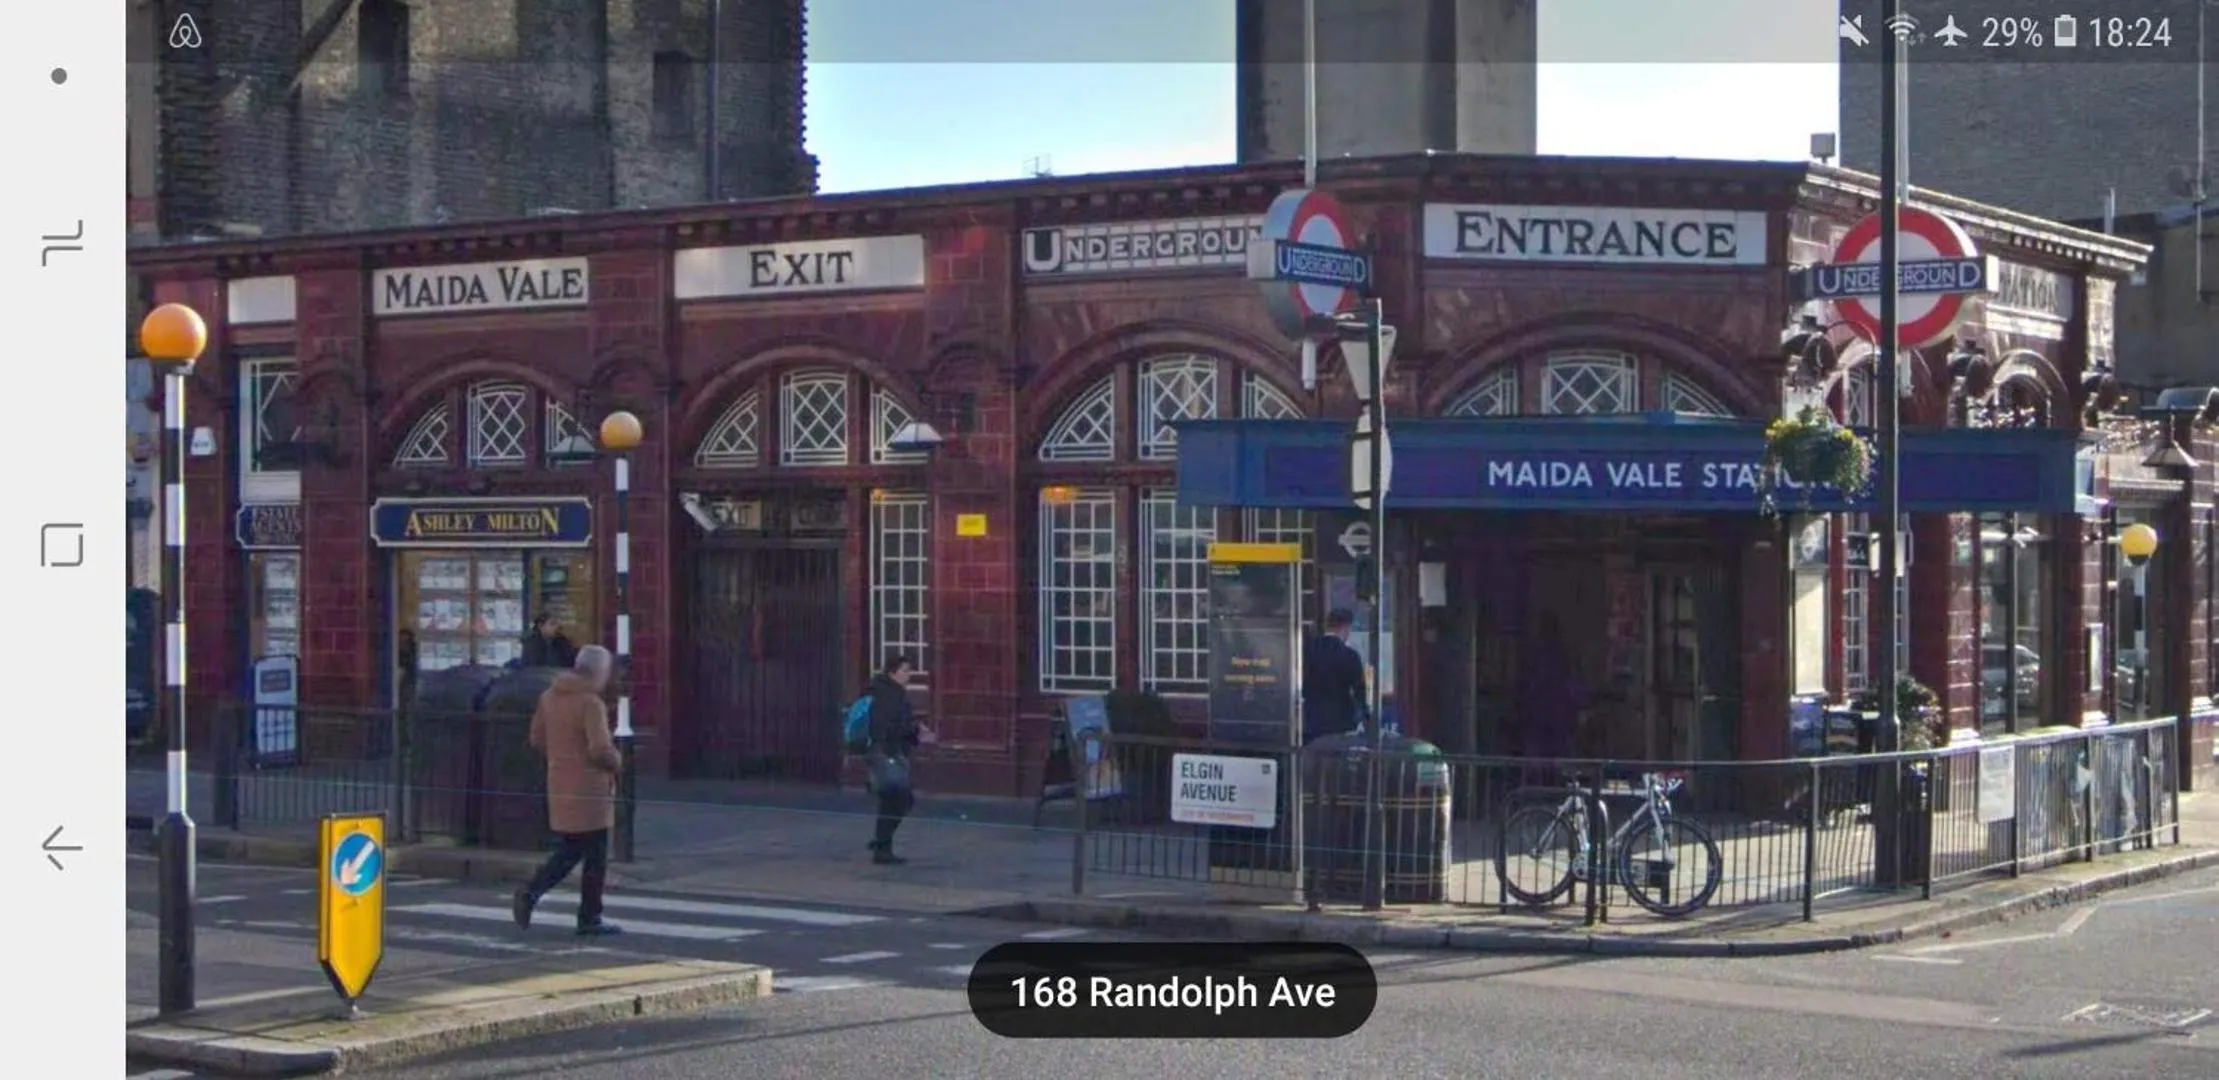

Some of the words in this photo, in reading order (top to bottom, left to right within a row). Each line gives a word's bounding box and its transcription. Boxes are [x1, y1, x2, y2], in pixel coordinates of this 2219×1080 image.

[1454, 211, 1737, 258] ENTRANCE
[749, 249, 853, 288] EXIT
[386, 273, 489, 309] MAIDA
[498, 266, 584, 302] VALE
[1487, 461, 1592, 488] MAIDA
[1607, 462, 1682, 488] VALE
[405, 510, 476, 537] ASHLEY
[488, 507, 560, 537] MILTON
[1181, 761, 1224, 780] ELGIN
[1180, 782, 1238, 802] AVENUE
